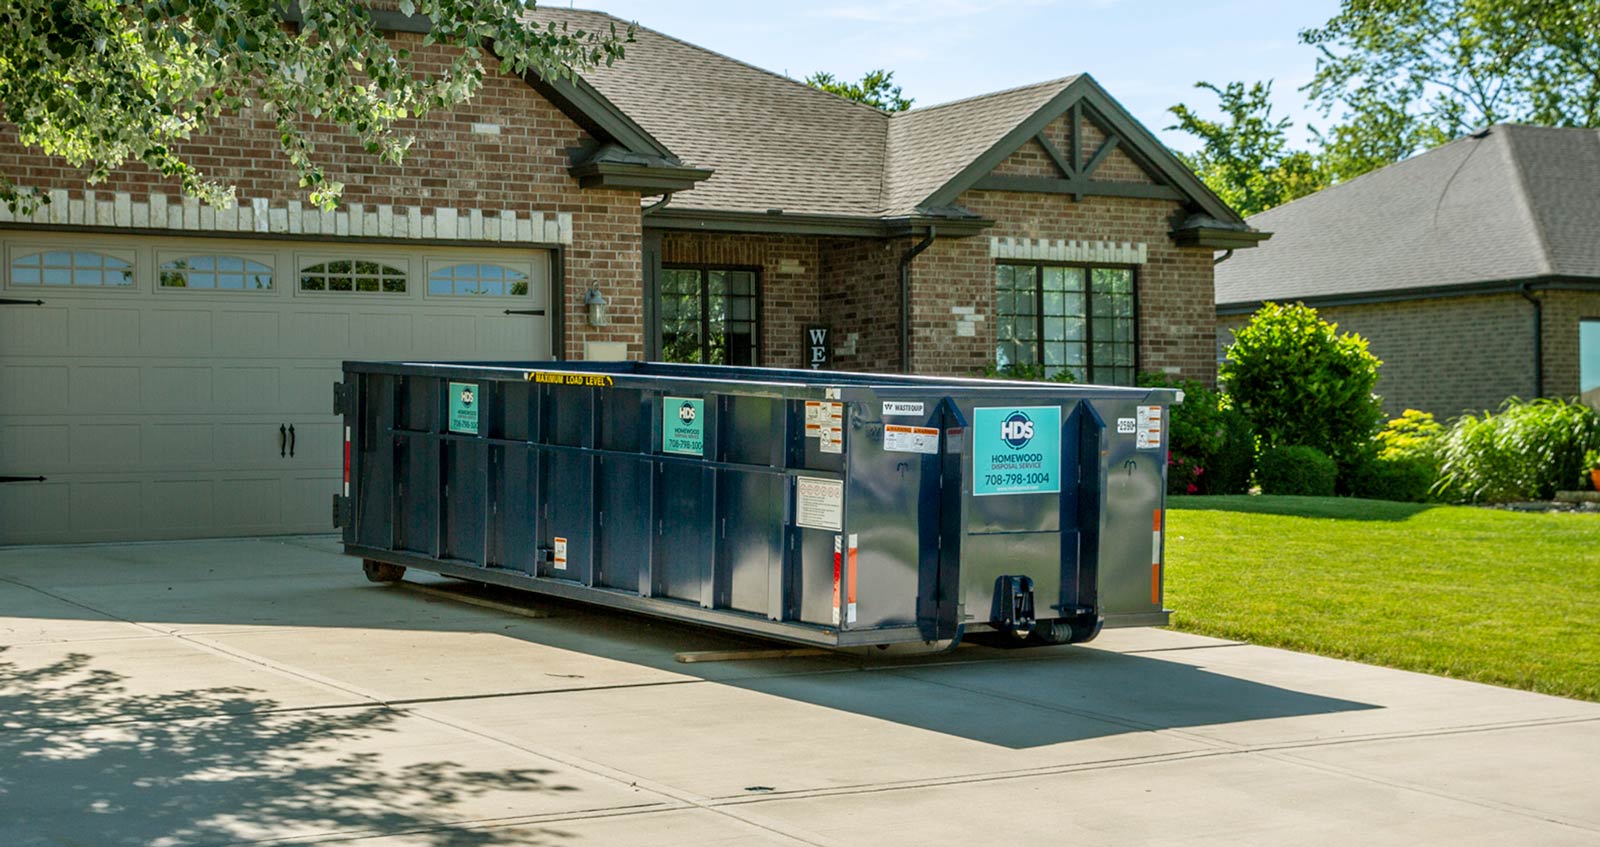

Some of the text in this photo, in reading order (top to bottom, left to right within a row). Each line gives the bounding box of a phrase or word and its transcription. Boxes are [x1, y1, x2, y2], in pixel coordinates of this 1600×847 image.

[809, 329, 827, 369] WE
[535, 373, 605, 387] MAXIMUM LOAD LEVEL
[461, 391, 474, 402] HDS
[679, 406, 695, 420] HDS
[895, 404, 923, 412] WASTEQUIP
[1001, 420, 1034, 440] HDS
[669, 439, 703, 450] 708-798-100
[991, 453, 1043, 463] HOMEWOOD
[985, 473, 1050, 485] 708-798-1004
